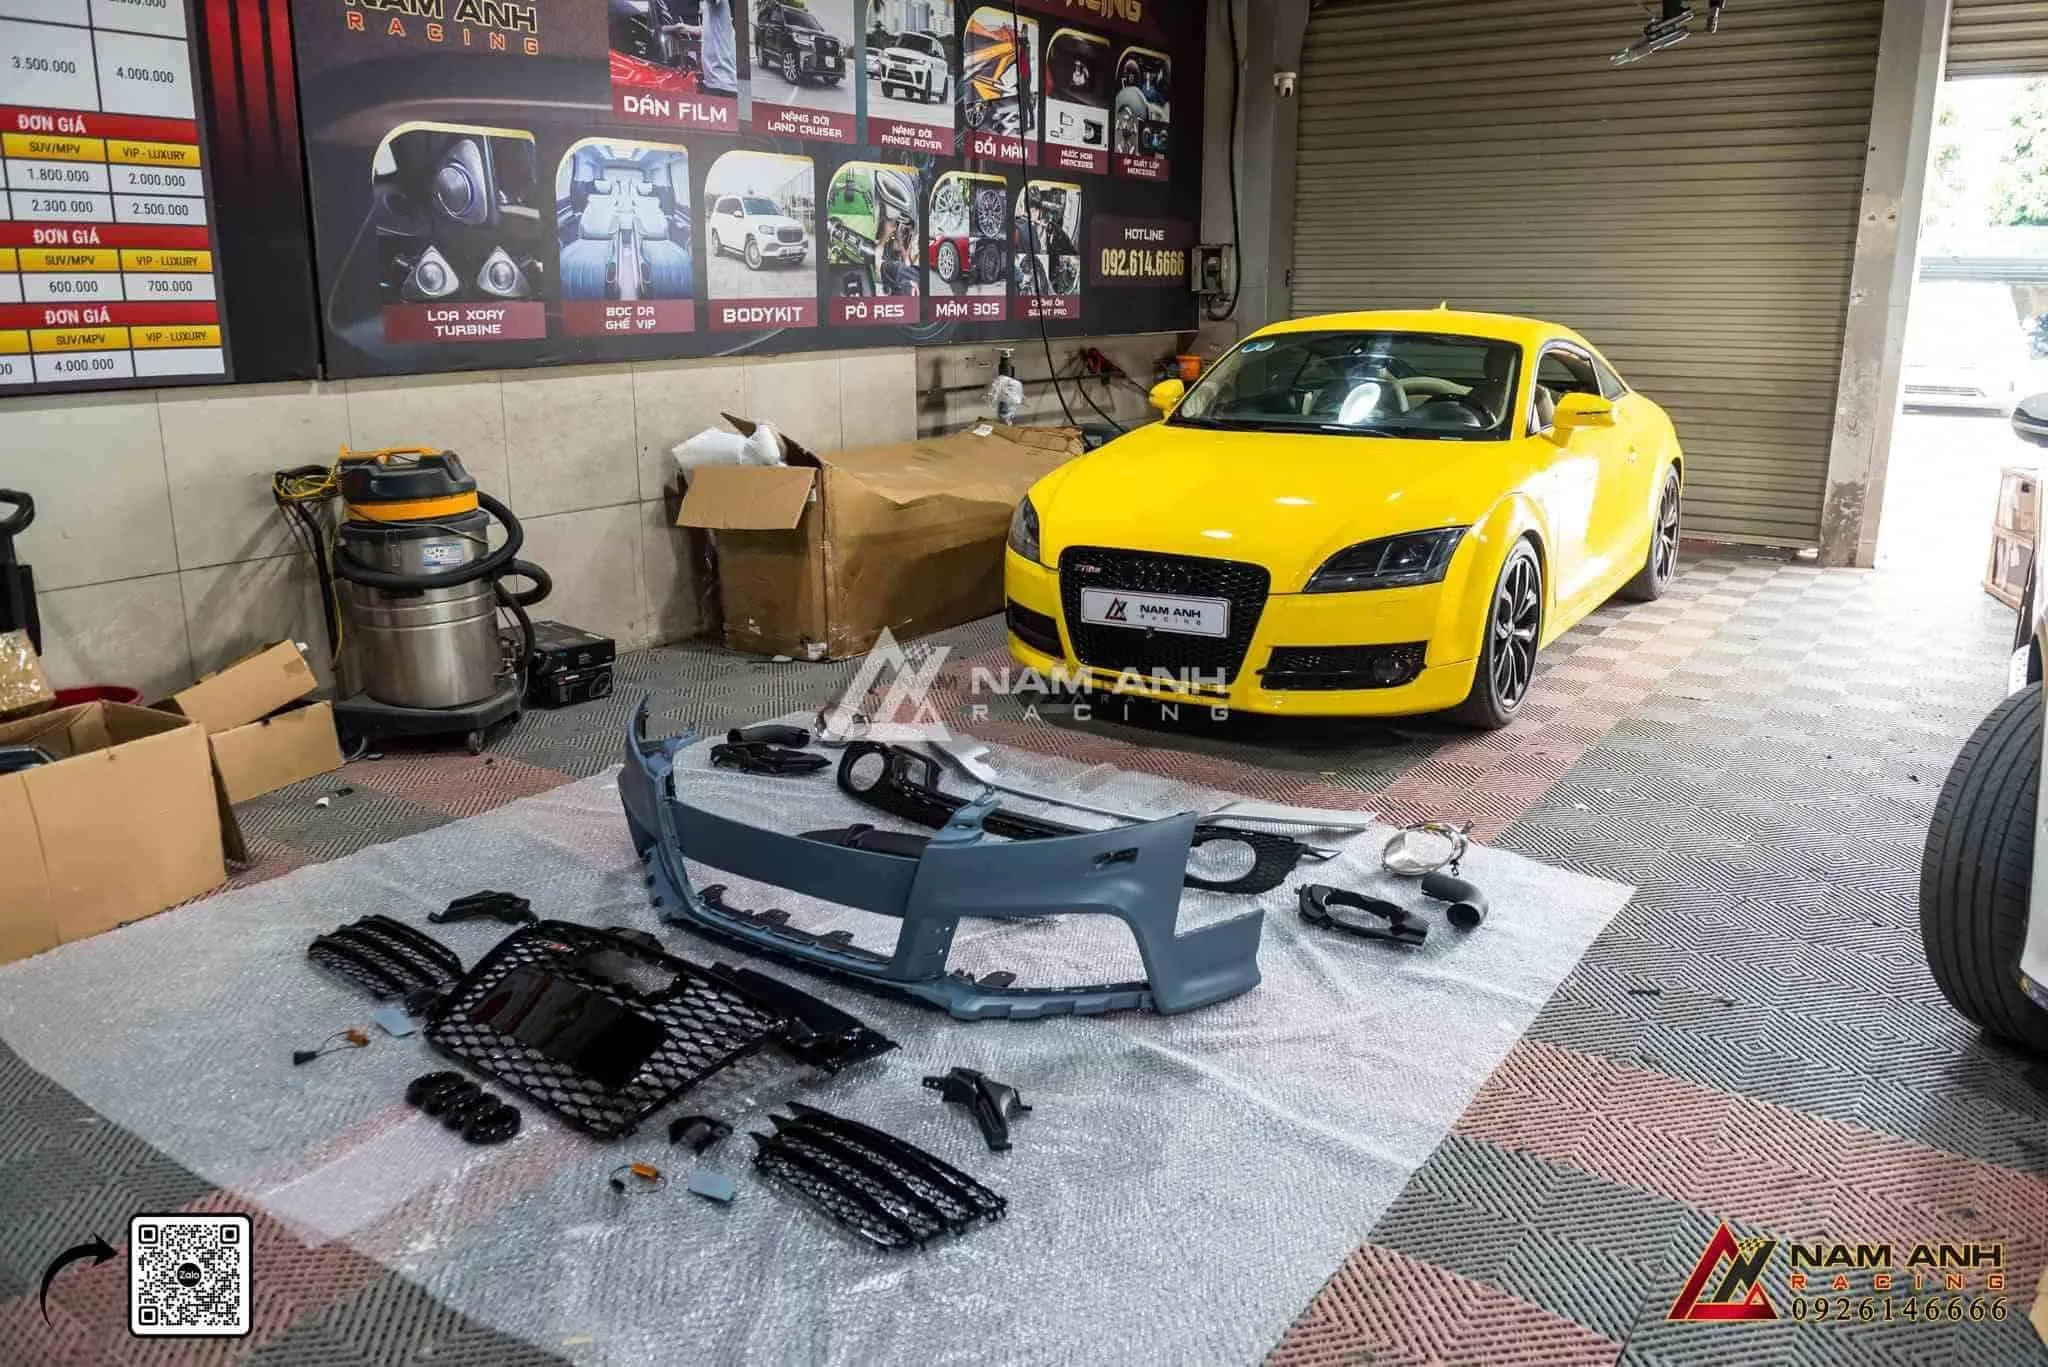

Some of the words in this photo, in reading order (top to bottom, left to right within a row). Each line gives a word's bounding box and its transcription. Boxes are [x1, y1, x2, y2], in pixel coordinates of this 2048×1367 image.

[454, 0, 537, 34] ANH
[346, 11, 539, 55] RACING
[12, 56, 76, 74] 3.500.000
[116, 66, 175, 84] 4.000.000
[623, 94, 669, 117] DÁN
[679, 102, 727, 123] FILM
[18, 114, 52, 131] ĐƠN
[58, 114, 86, 134] GIÁ
[767, 120, 796, 133] LAND
[800, 125, 842, 138] CRUISER
[29, 142, 80, 154] SUV/MPV
[123, 147, 139, 158] VIP
[150, 149, 186, 160] LUXURY
[27, 168, 89, 183] 1.800.000
[128, 172, 185, 187] 2.000.000
[32, 199, 93, 214] 2.300.000
[132, 203, 189, 216] 2.500.000
[33, 229, 70, 244] ĐƠN
[72, 226, 101, 244] GIÁ
[1124, 227, 1165, 241] HOTLINE
[44, 255, 95, 266] SUV/MPV
[136, 256, 152, 266] VIP
[161, 255, 199, 266] LUXURY
[1101, 247, 1185, 277] 092.614.6666
[49, 279, 98, 294] 600.000
[148, 279, 193, 293] 700.000
[45, 310, 79, 325] ĐƠN
[83, 305, 111, 324] GIÁ
[427, 309, 459, 322] LOA
[466, 309, 506, 322] XOAY
[722, 306, 804, 324] BODYKIT
[845, 301, 867, 321] PÔ
[873, 303, 904, 320] RES
[936, 300, 968, 318] MÂM
[973, 303, 1000, 316] 305
[434, 324, 502, 337] TURBINE
[637, 319, 657, 329] VIP
[56, 334, 107, 346] SUV/MPV
[145, 332, 162, 342] VIP
[170, 331, 208, 342] LUXURY
[55, 358, 114, 373] 4.000.000
[1140, 604, 1169, 615] NAM
[1173, 608, 1201, 619] ANH
